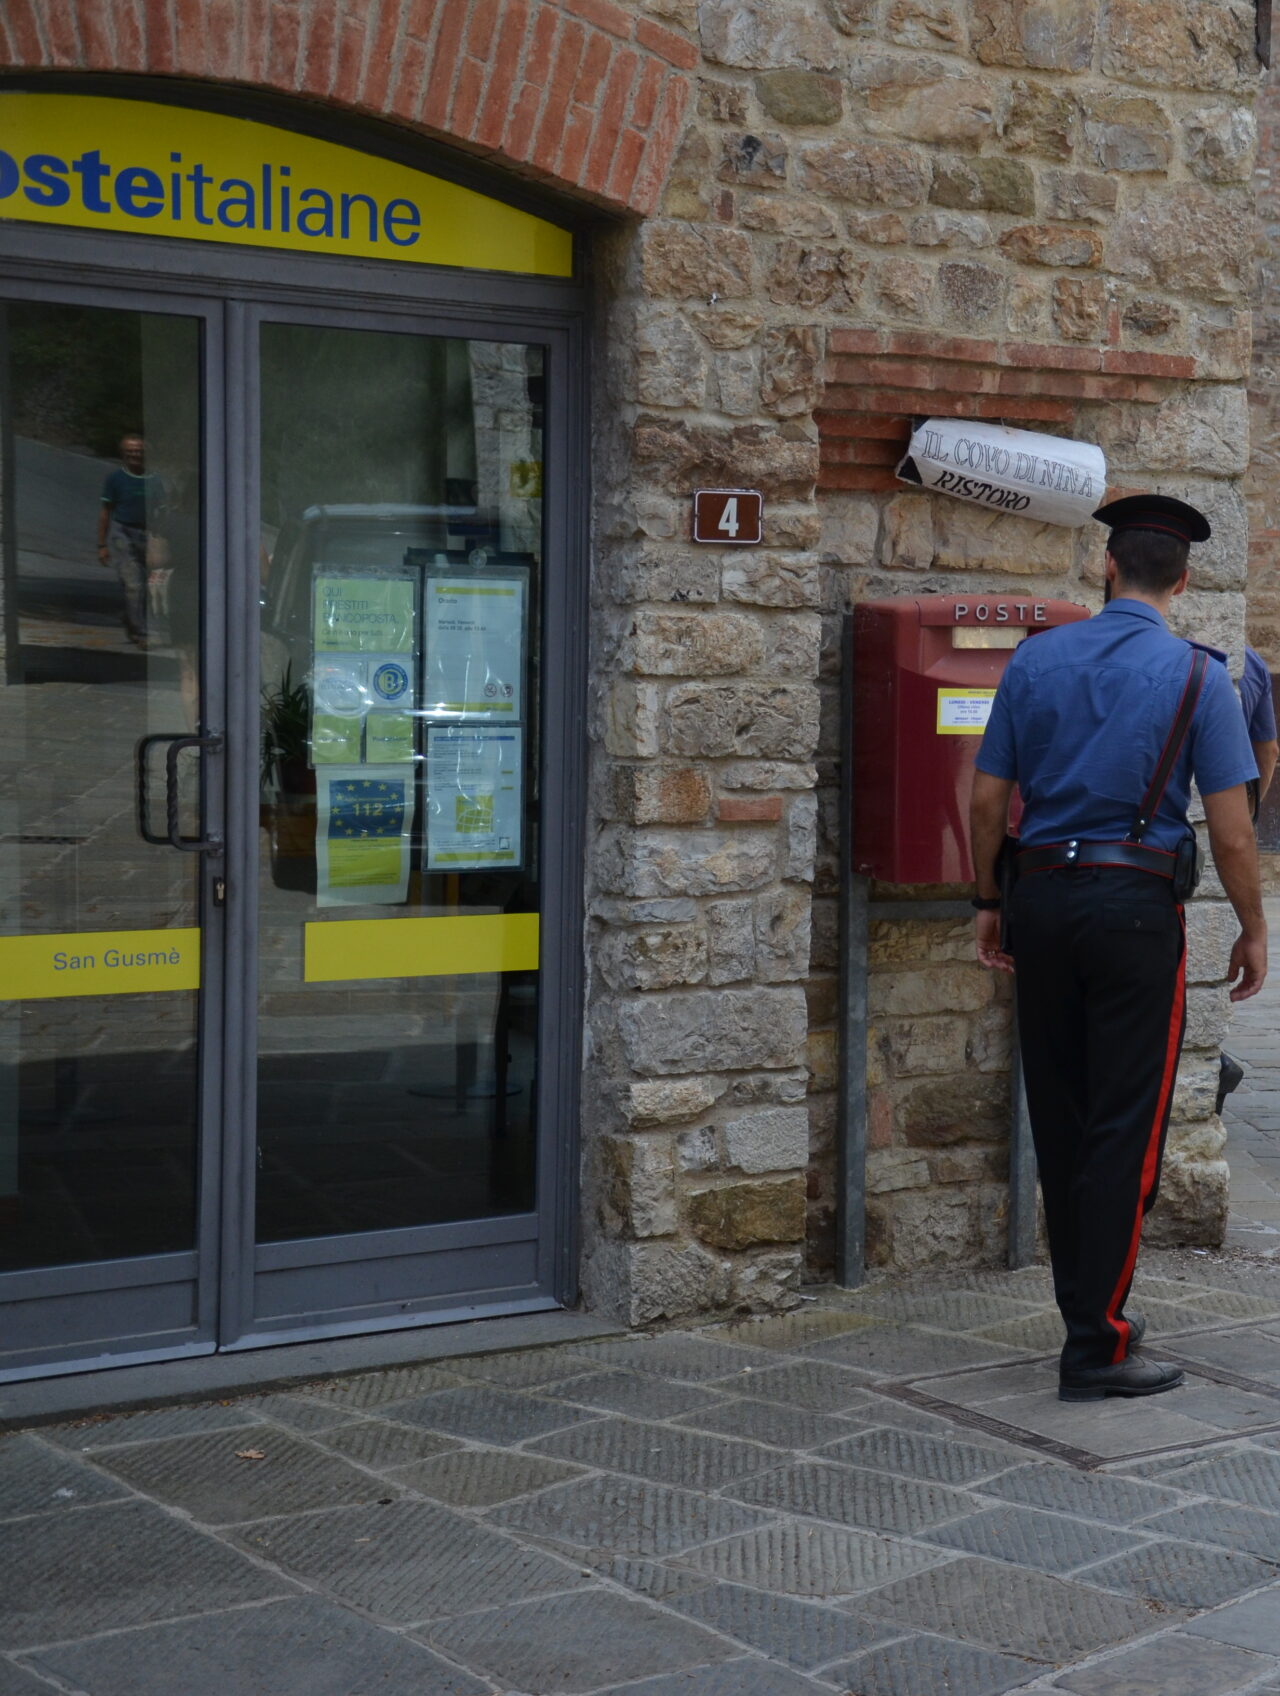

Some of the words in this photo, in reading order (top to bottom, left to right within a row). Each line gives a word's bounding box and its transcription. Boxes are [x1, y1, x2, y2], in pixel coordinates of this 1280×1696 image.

[921, 429, 949, 462] IL
[953, 437, 1011, 476] COVO
[1013, 451, 1037, 485] DI
[1039, 458, 1093, 498] NINA
[931, 469, 1032, 512] RISTORO
[717, 496, 740, 538] 4
[954, 603, 1048, 622] POSTE
[352, 802, 385, 817] 112
[53, 951, 96, 971] San
[103, 946, 180, 968] Gusmè
